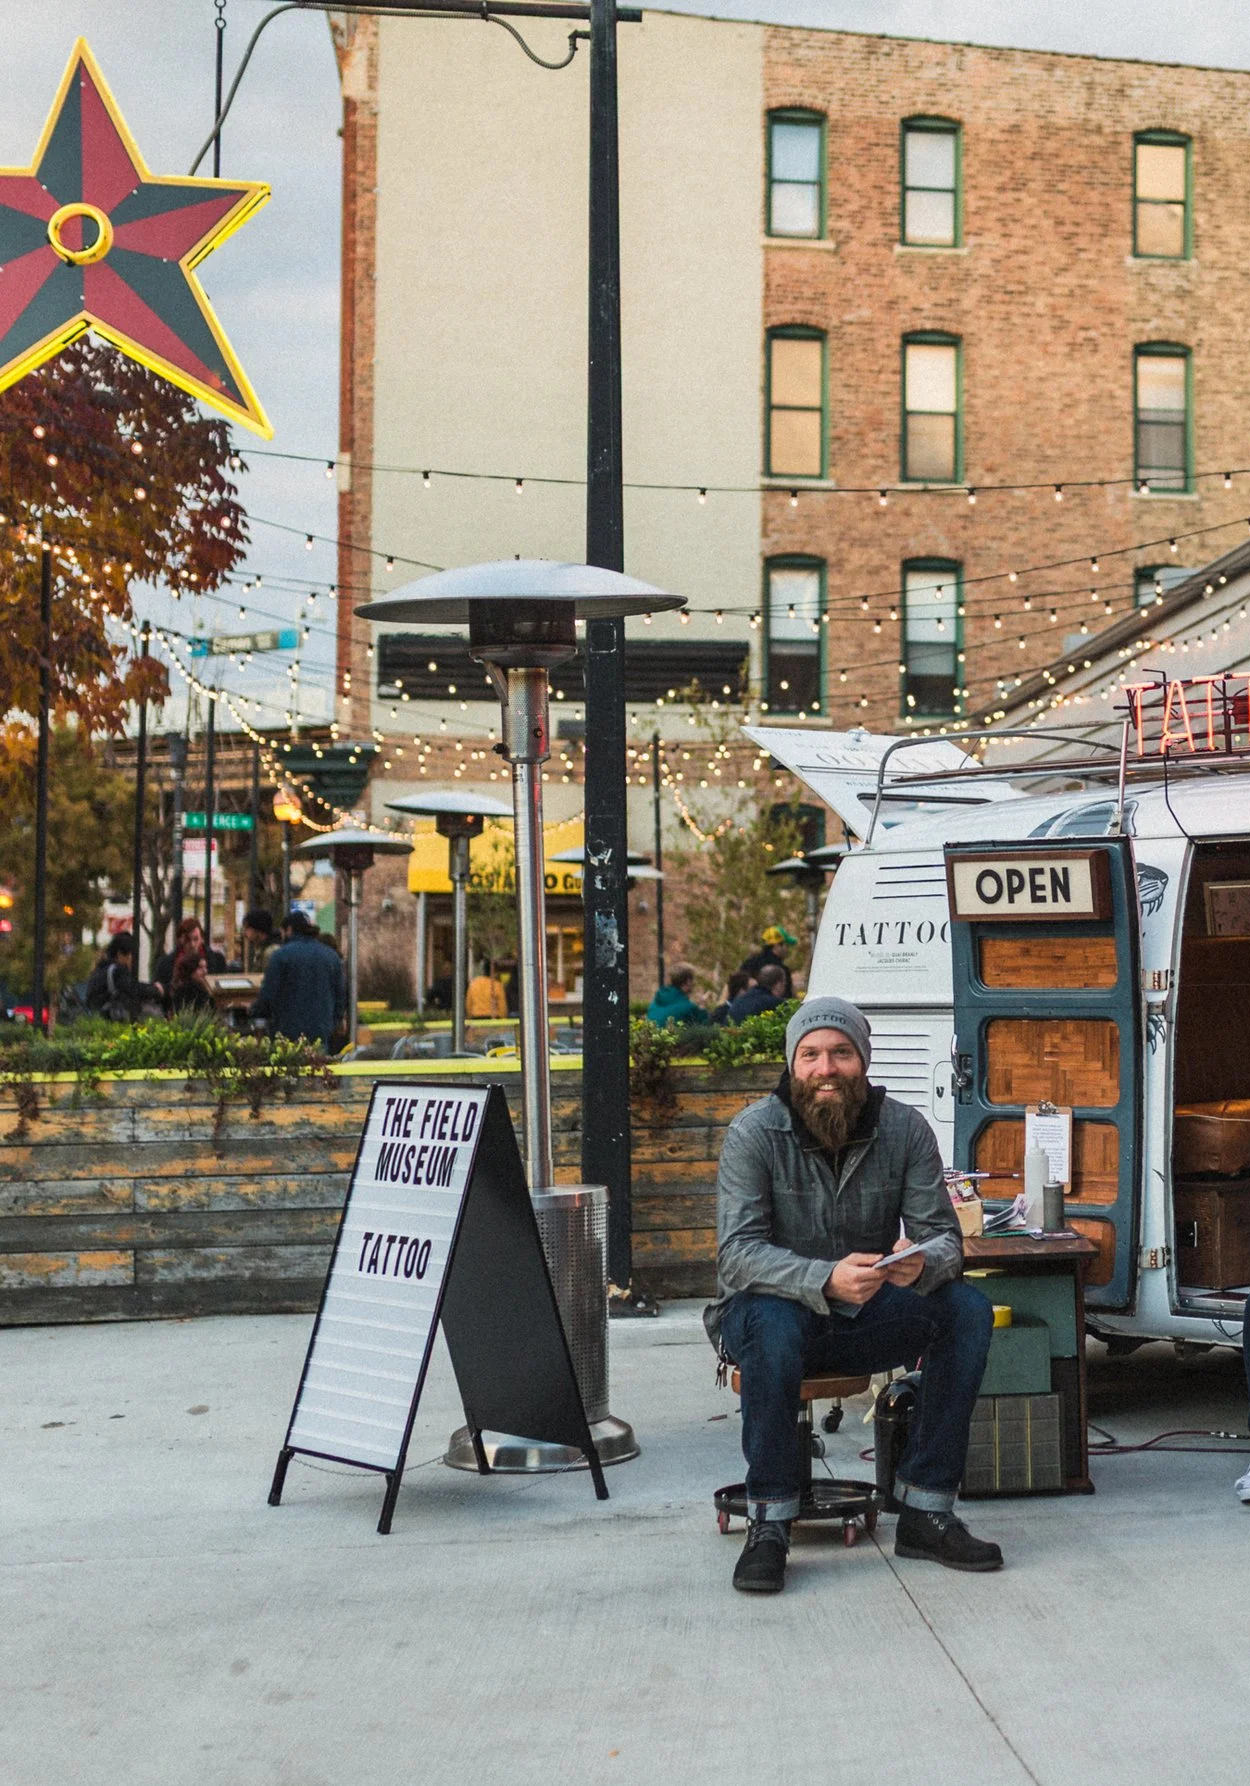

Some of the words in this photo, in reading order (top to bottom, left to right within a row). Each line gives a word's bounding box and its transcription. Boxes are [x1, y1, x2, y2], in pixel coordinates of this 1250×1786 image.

[975, 866, 1072, 905] OPEN
[801, 1014, 847, 1028] TATTOO
[381, 1097, 418, 1139] THE
[419, 1098, 479, 1143] FIELD
[374, 1142, 459, 1188] MUSEUM
[358, 1231, 433, 1280] TATTOO
